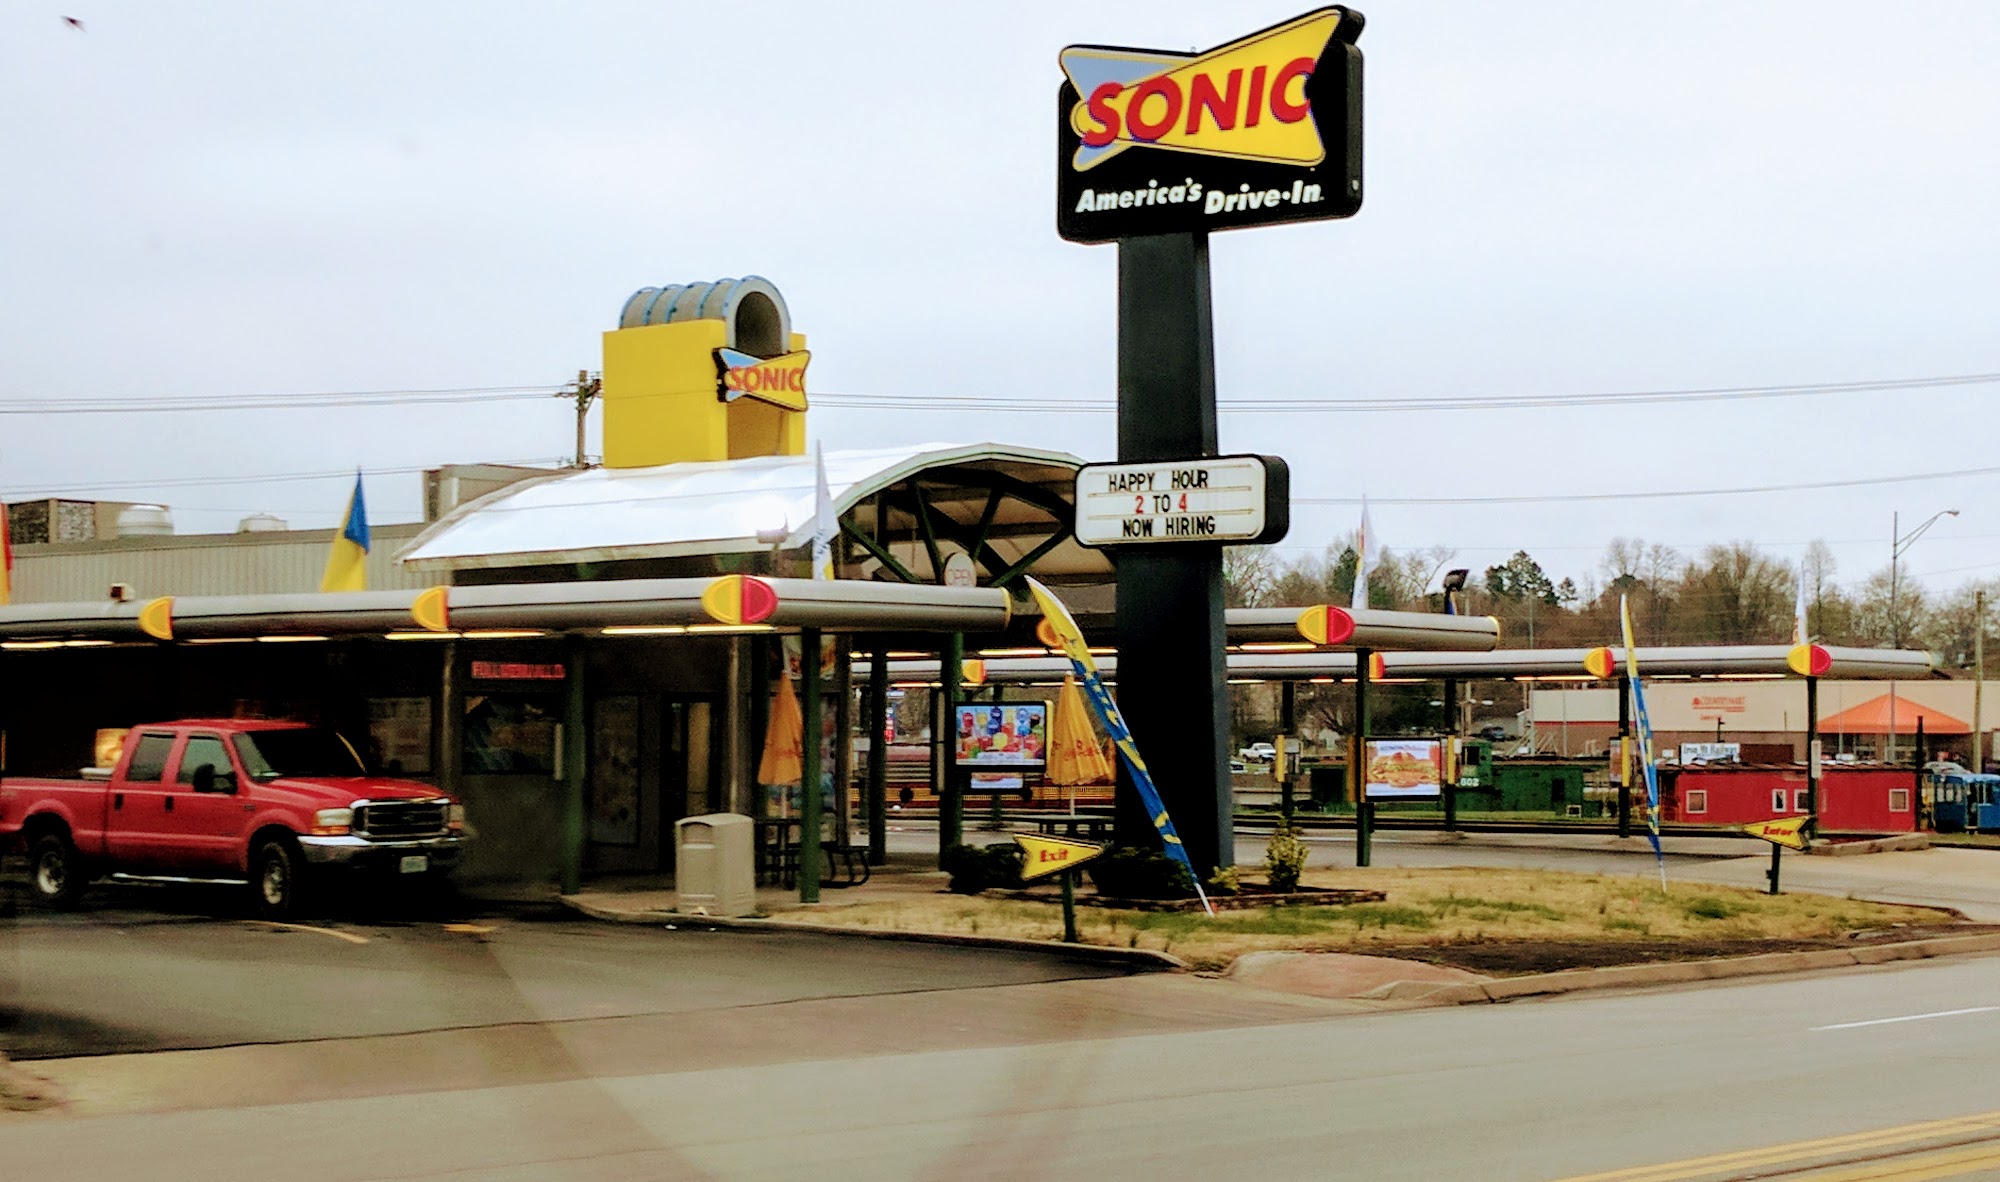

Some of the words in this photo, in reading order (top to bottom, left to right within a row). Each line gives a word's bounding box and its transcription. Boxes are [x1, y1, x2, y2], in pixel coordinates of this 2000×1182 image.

[1080, 57, 1316, 147] SONIC
[1075, 177, 1202, 213] America's
[728, 366, 804, 392] SONIC
[1109, 473, 1155, 492] HAPPY
[1171, 470, 1208, 489] HOUR
[1135, 495, 1144, 514] 2
[1153, 494, 1171, 514] TO
[1178, 493, 1188, 512] 4
[1122, 518, 1154, 537] NOW
[1166, 515, 1216, 535] HIRING
[1040, 848, 1068, 862] Exit
